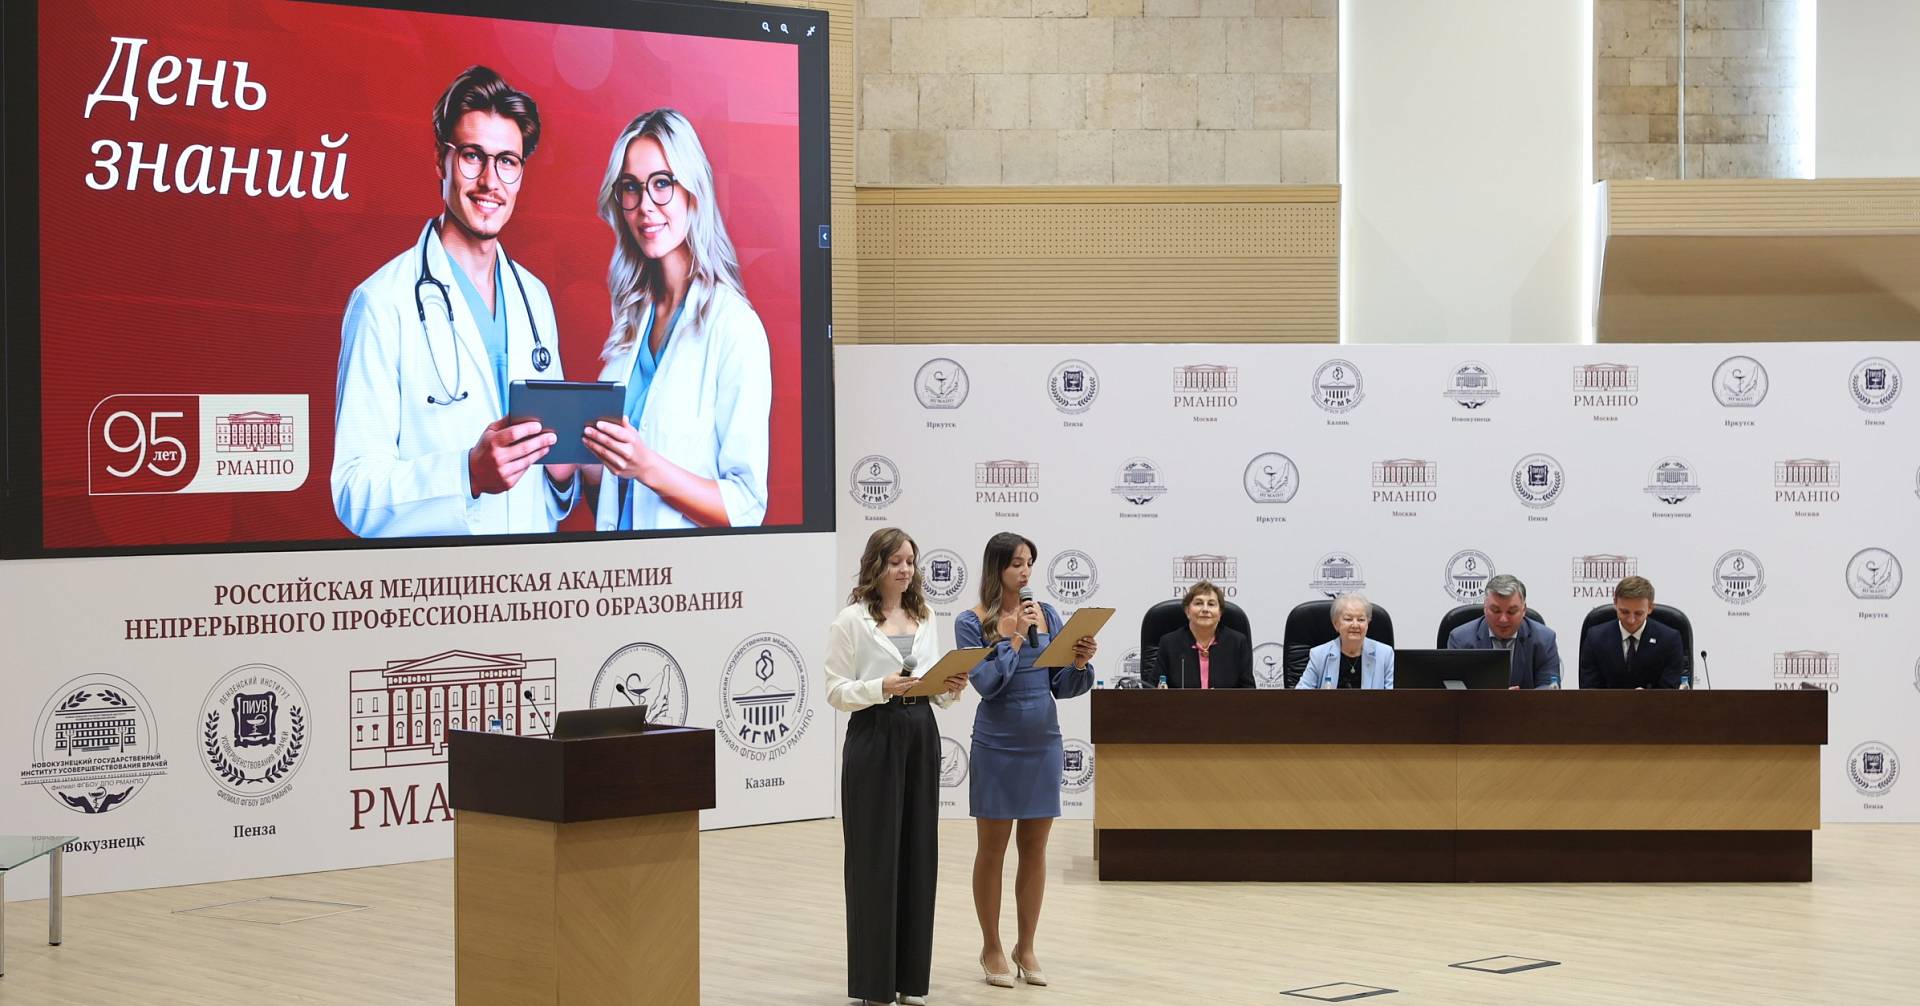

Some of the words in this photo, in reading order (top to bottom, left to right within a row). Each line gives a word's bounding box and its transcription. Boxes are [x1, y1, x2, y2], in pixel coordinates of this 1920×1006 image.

[84, 36, 267, 121] День
[85, 132, 350, 201] знаний
[1174, 396, 1238, 407] РМАНПО
[1574, 395, 1638, 406] РМАНПО
[926, 421, 957, 430] Иркутск
[1724, 420, 1756, 428] Иркутск
[104, 411, 187, 478] 95
[153, 450, 177, 461] лет
[216, 459, 294, 475] РМАНПО
[976, 492, 1040, 503] РМАНПО
[1373, 491, 1437, 502] РМАНПО
[1776, 491, 1840, 502] РМАНПО
[1256, 516, 1287, 524] Иркутск
[214, 577, 374, 606] РОССИЙСКАЯ
[379, 572, 552, 602] МЕДИЦИНСКАЯ
[557, 567, 673, 593] АКАДЕМИЯ
[1174, 586, 1238, 597] РМО
[1573, 586, 1617, 597] РМАН
[124, 611, 326, 640] НЕПРЕРЫВНОГО
[332, 599, 590, 631] ПРОФЕССИОНАЛЬНОГО
[596, 591, 743, 617] ОБРАЗОВАНИЯ
[1858, 611, 1889, 620] Иркутск
[1775, 682, 1840, 694] РМПО
[242, 699, 268, 715] ПИУВ
[716, 719, 739, 751] Филиал
[740, 748, 767, 762] ФГБОУ
[768, 744, 787, 761] ДПО
[787, 708, 814, 749] РМАНПО
[738, 722, 790, 744] КГМА
[20, 768, 57, 777] ИНСТИТУТ
[58, 762, 142, 774] УСОВЕРШЕНСТВОВАНИЯ
[142, 760, 168, 769] ВРАЧЕЙ
[31, 758, 93, 769] НОВОКУЗНЕЦКИЙ
[93, 754, 161, 765] ГОСУДАРСТВЕННЫЙ
[745, 776, 785, 790] Казань
[349, 782, 454, 830] РМА
[233, 825, 277, 839] Пенза
[62, 836, 146, 854] вокузнецк
